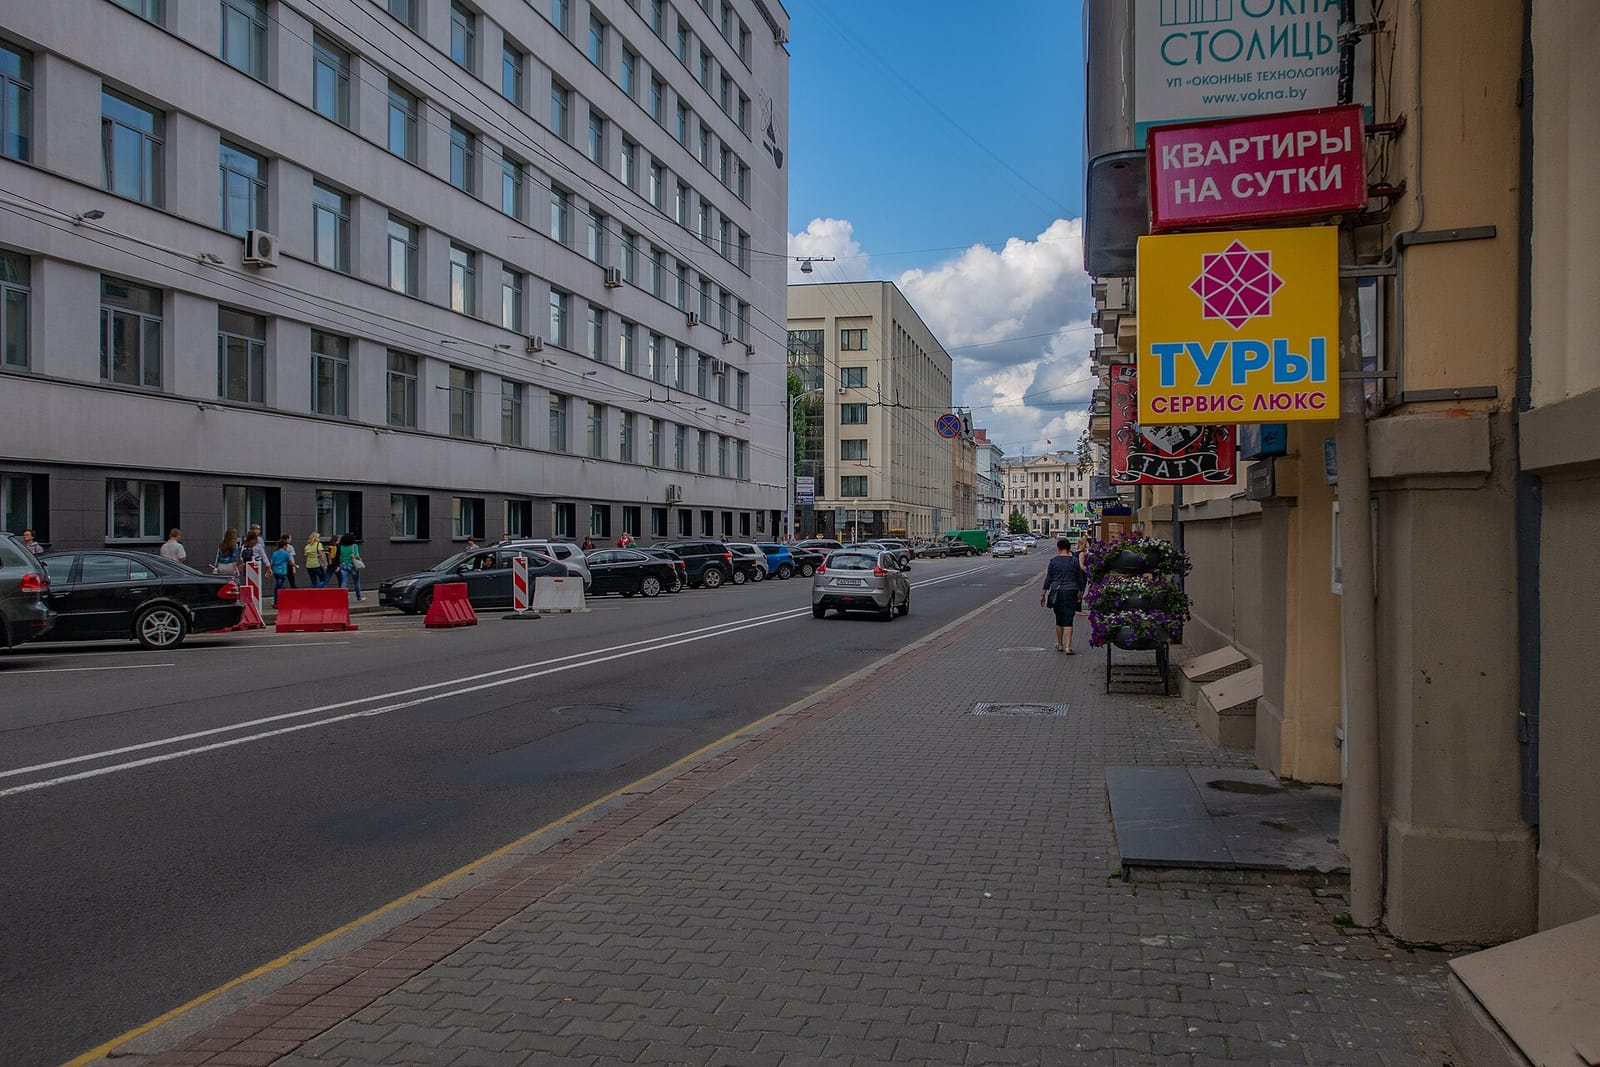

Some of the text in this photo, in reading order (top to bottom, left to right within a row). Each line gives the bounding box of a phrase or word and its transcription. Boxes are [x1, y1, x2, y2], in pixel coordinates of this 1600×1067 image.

[1166, 77, 1182, 88] УП
[1185, 72, 1253, 87] «ОКОННЫЕ
[1202, 86, 1308, 104] www.vokna.by
[1161, 126, 1352, 170] КВАРТИРЫ
[1174, 164, 1342, 205] НА СУТКИ
[1151, 337, 1326, 387] ТУРЫ
[1151, 391, 1327, 415] СЕРВИС ЛЮКС
[1141, 455, 1205, 478] ТАТУ
